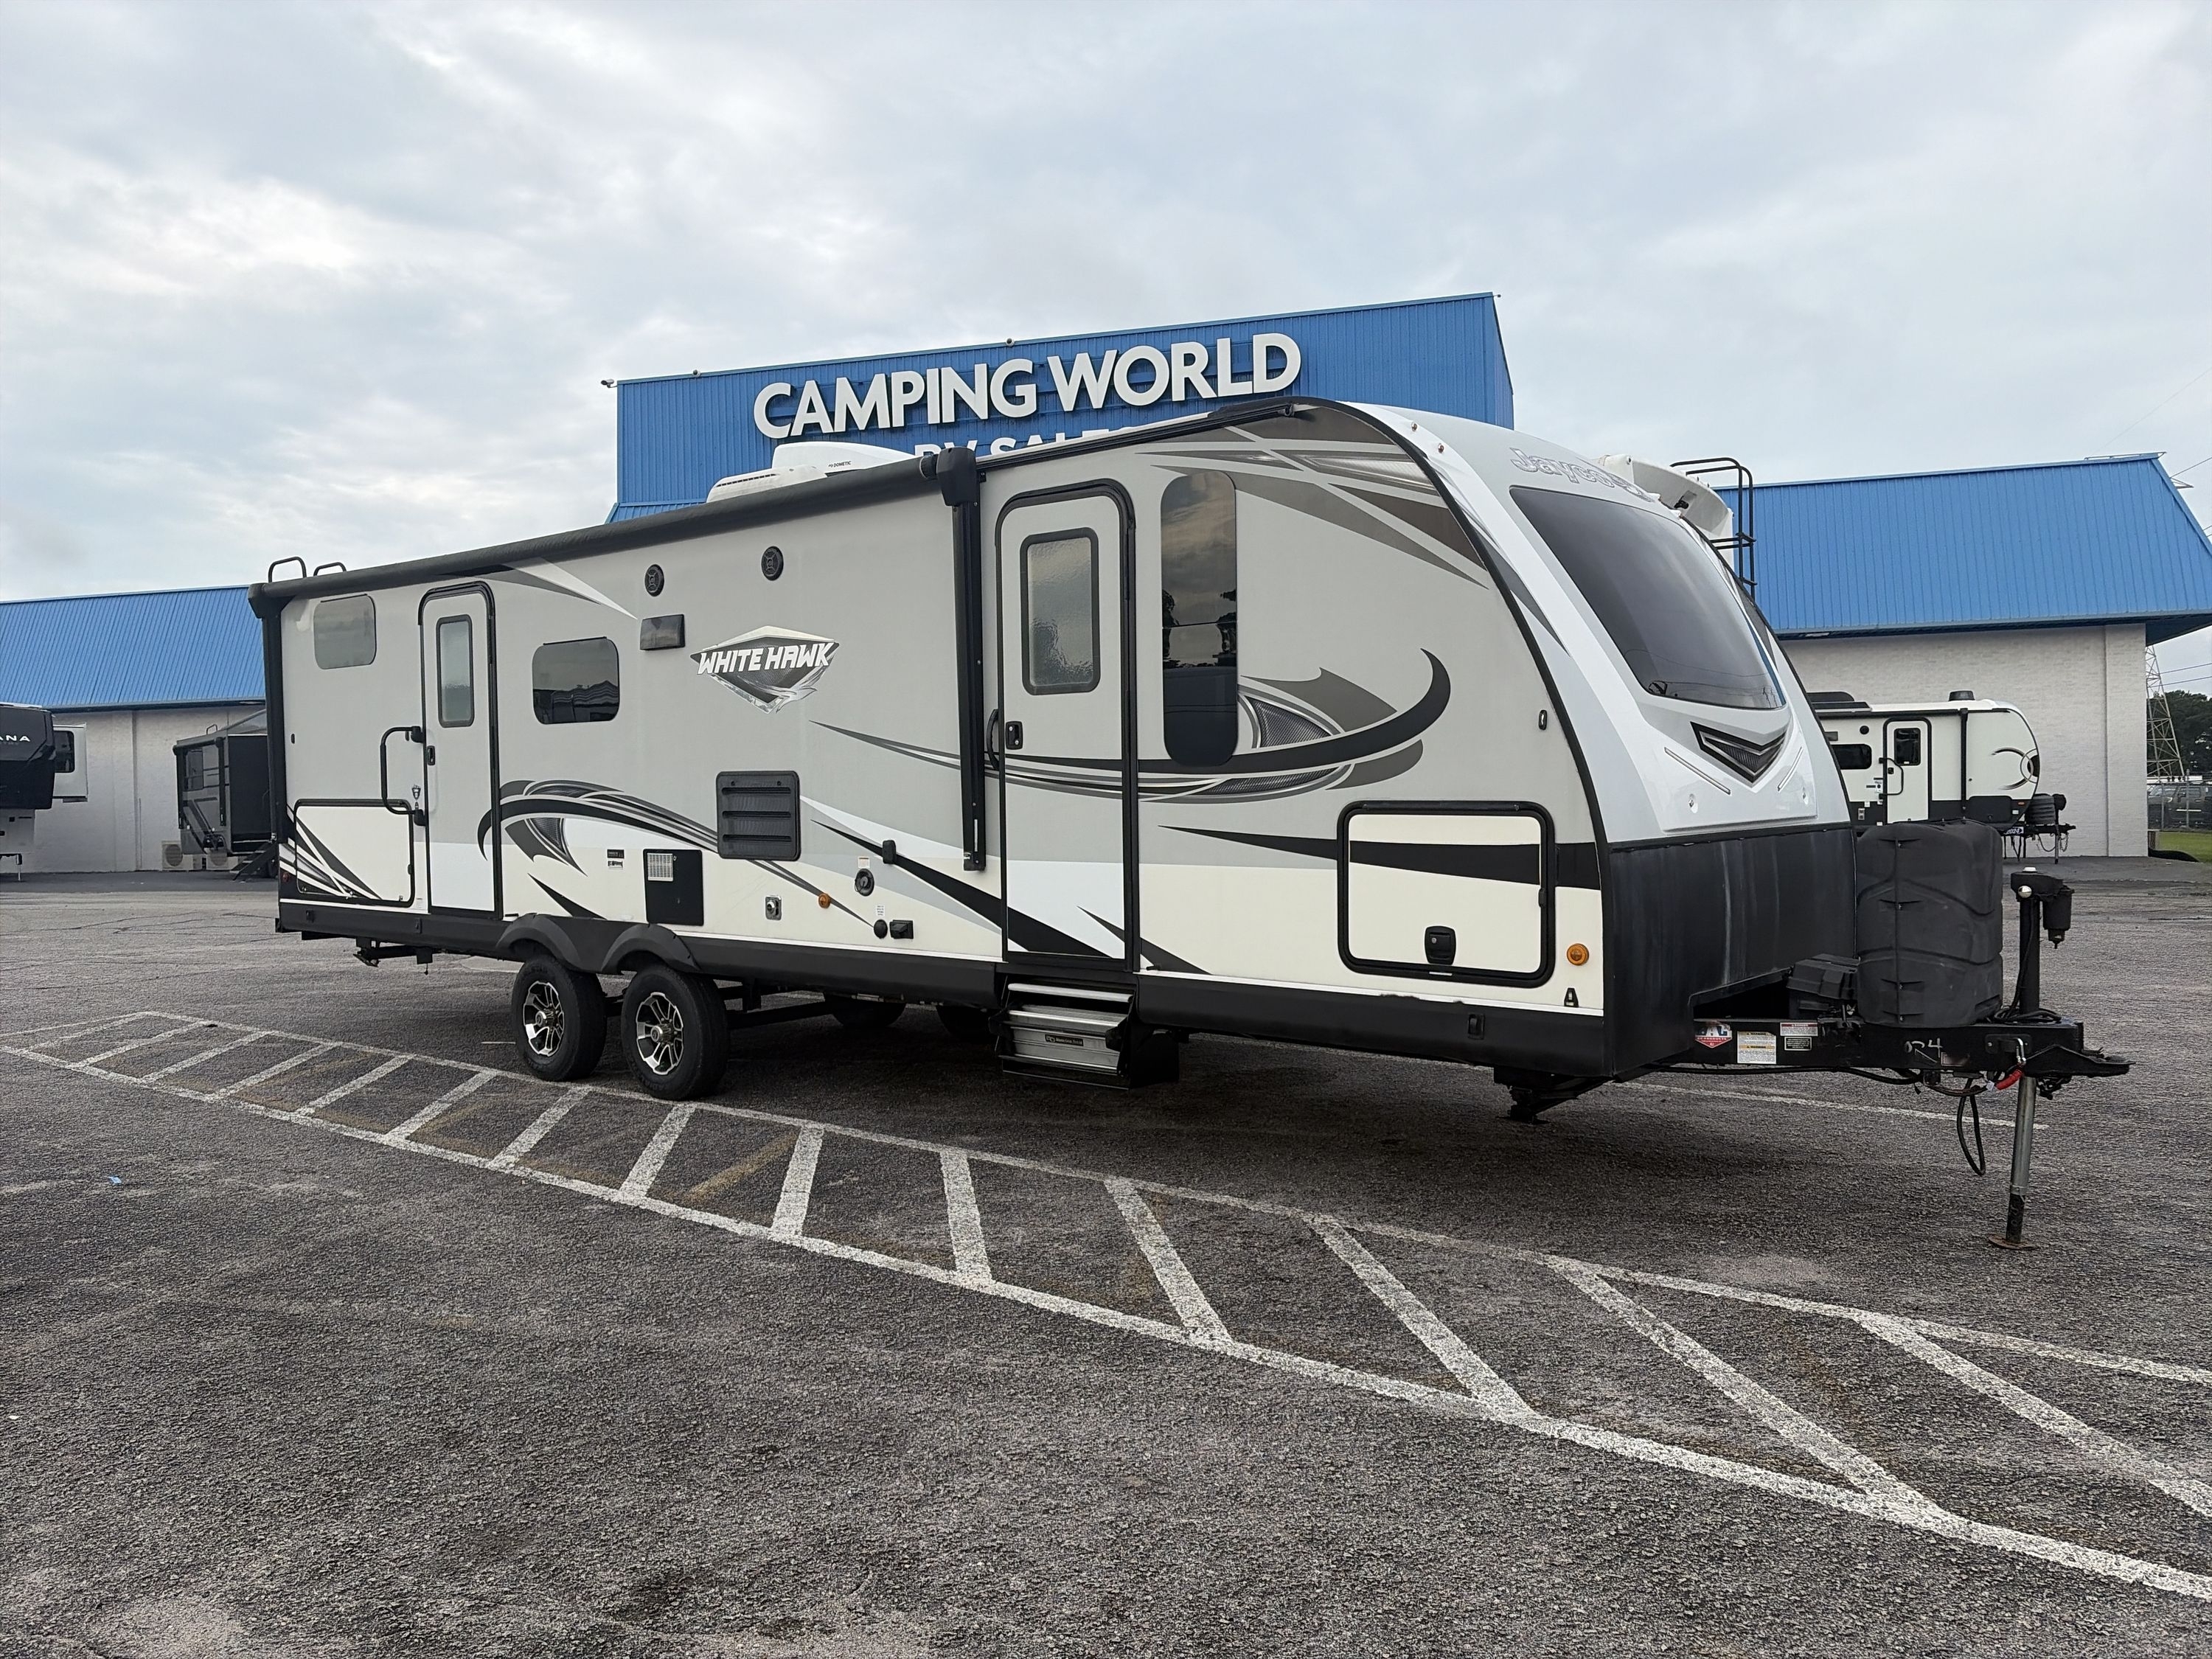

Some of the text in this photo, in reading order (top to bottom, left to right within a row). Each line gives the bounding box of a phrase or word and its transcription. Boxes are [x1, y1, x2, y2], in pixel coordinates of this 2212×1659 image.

[754, 333, 1301, 439] CAMPING WORLD
[1509, 447, 1615, 488] Jayco
[696, 642, 835, 675] WHITE HAWK
